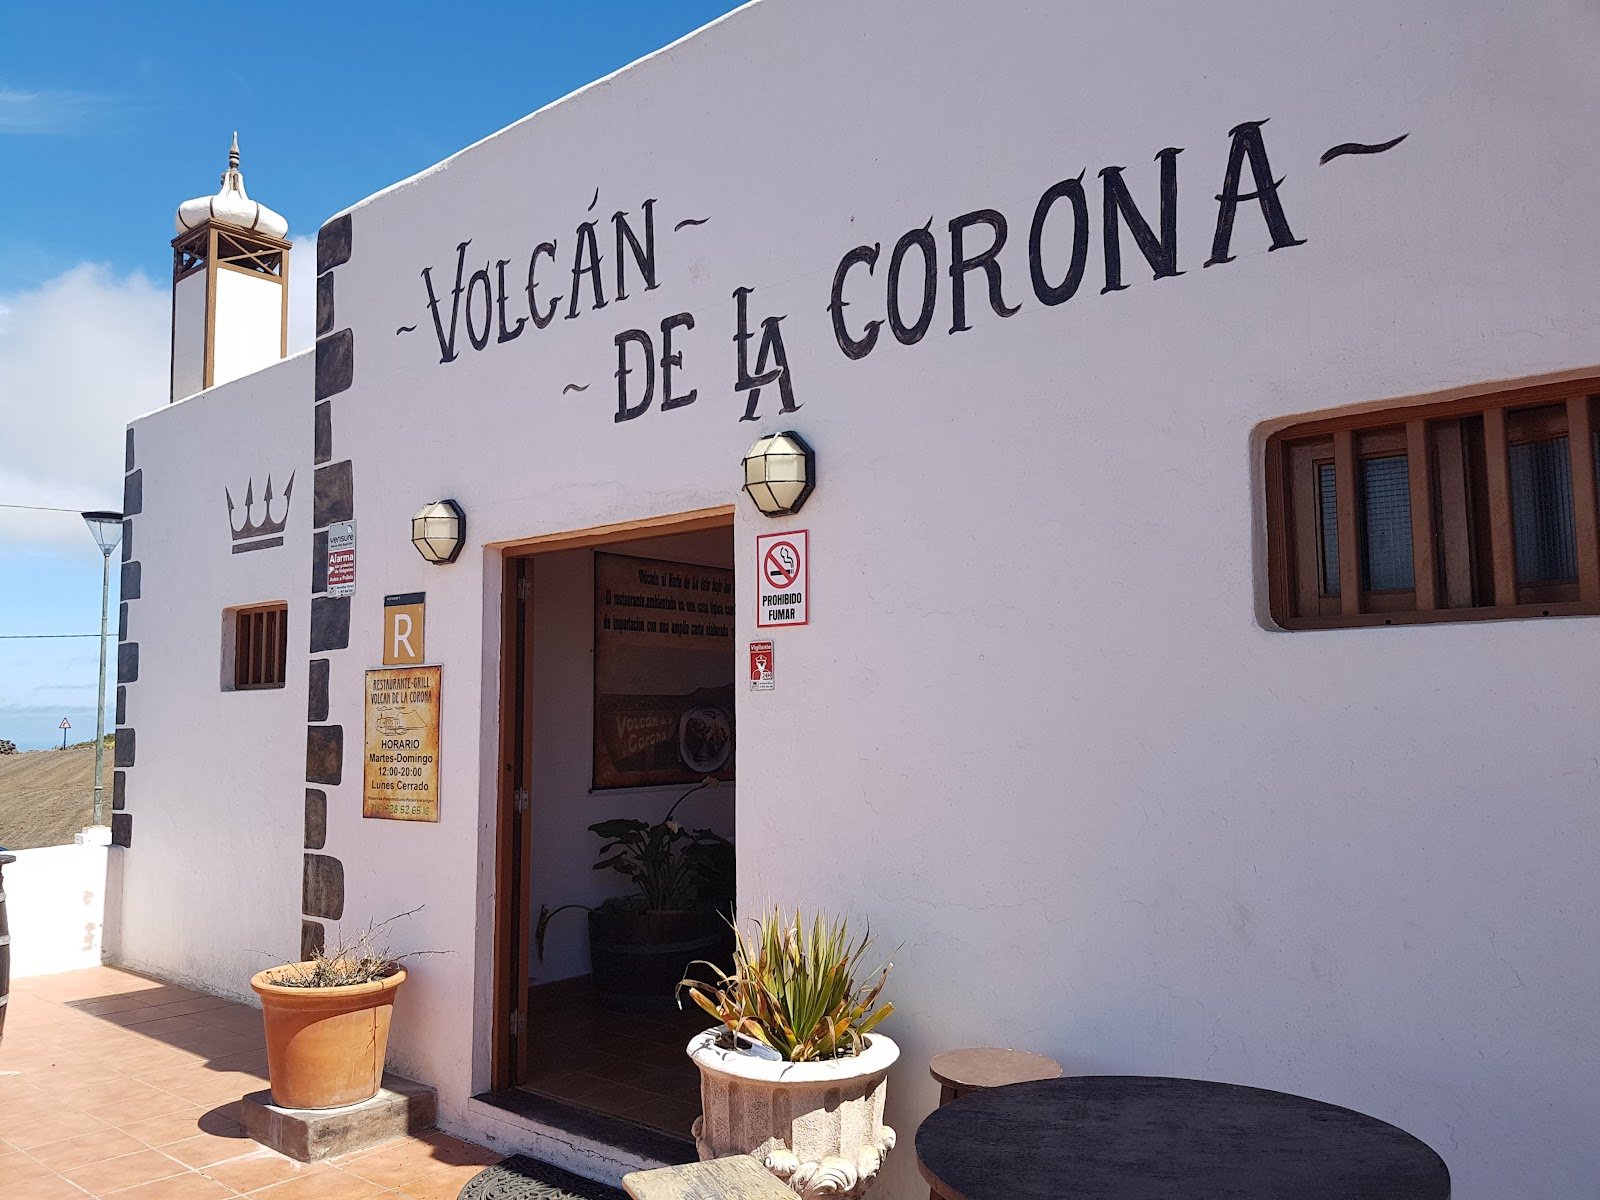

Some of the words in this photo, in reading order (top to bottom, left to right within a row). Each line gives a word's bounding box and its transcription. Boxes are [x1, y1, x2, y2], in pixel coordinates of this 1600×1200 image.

[420, 187, 661, 364] VOLCÁN
[614, 312, 697, 423] DE
[732, 286, 805, 422] LA
[827, 118, 1307, 361] CORONA
[330, 534, 354, 544] verisure
[330, 554, 354, 564] Alarma
[762, 593, 802, 606] PROHIBIDO
[768, 608, 795, 621] FUMAR
[393, 613, 416, 658] R
[750, 644, 771, 652] Vigilante
[392, 692, 399, 704] DE
[400, 692, 408, 704] LA
[409, 690, 432, 704] CORONA
[381, 739, 420, 750] HORARIO
[369, 753, 433, 766] Martes-Domingo
[378, 766, 422, 777] 12:00-20:00
[371, 780, 394, 790] Lunes
[397, 780, 429, 791] Cerrado
[400, 805, 410, 815] 52
